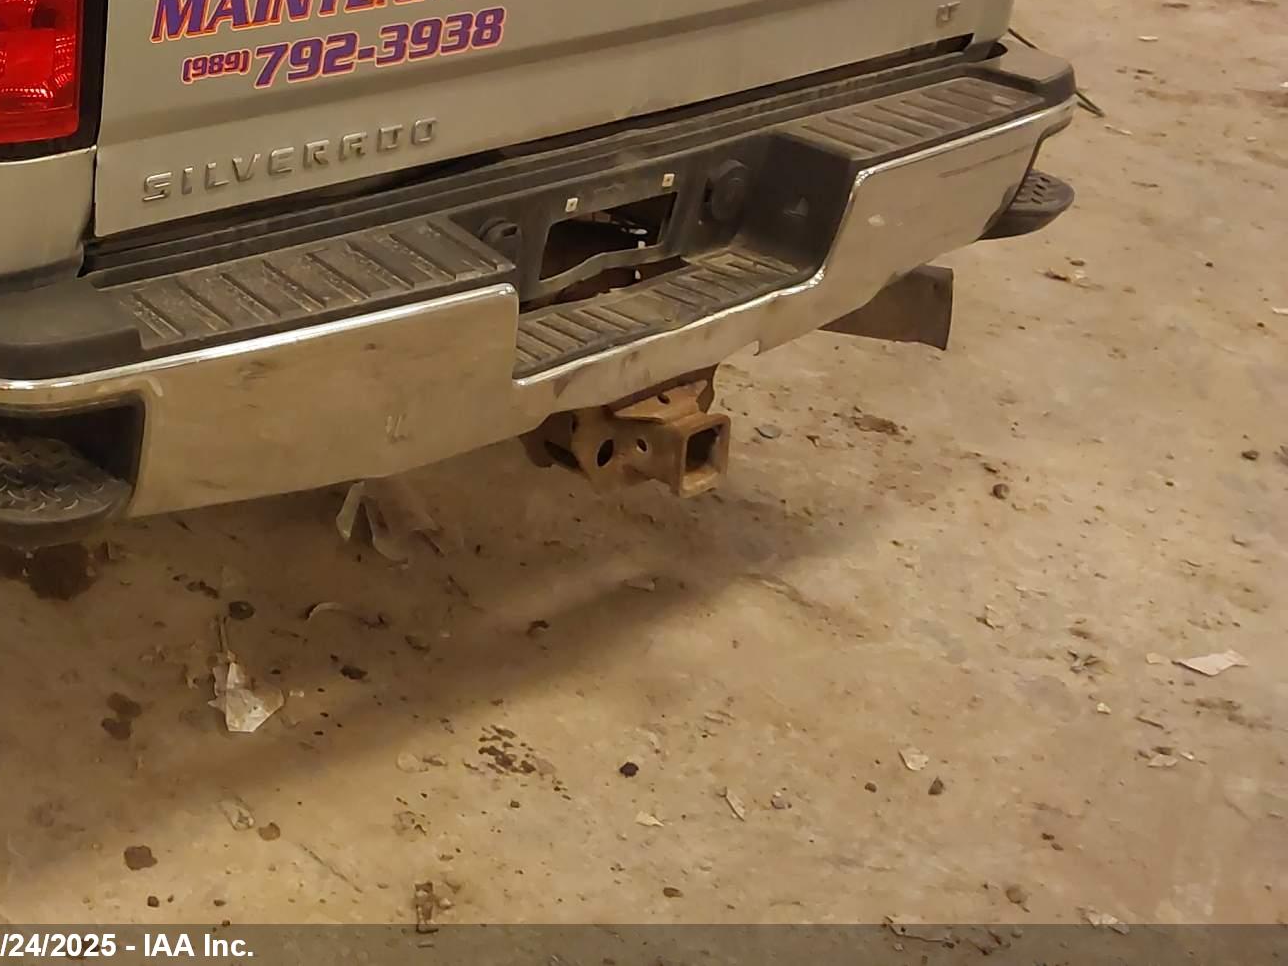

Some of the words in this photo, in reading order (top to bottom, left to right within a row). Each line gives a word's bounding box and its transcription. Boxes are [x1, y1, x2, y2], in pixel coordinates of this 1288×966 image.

[182, 50, 251, 83] (989)
[254, 7, 505, 89] 792-3938
[142, 117, 438, 202] SILVERADO
